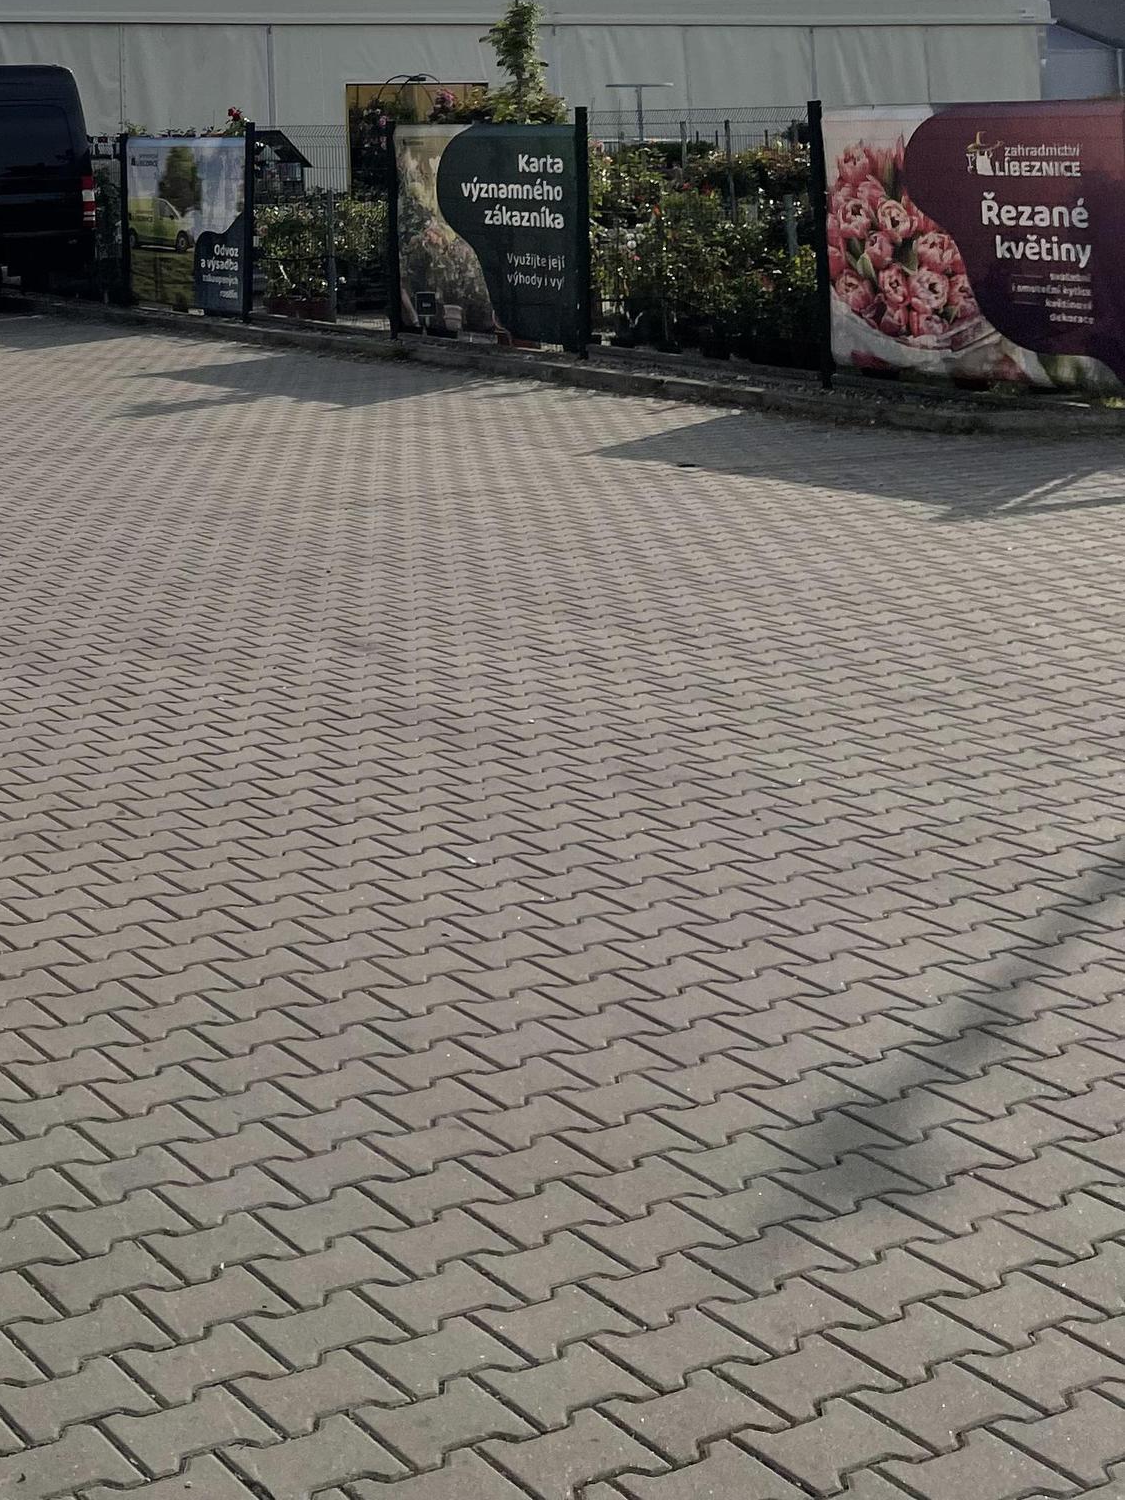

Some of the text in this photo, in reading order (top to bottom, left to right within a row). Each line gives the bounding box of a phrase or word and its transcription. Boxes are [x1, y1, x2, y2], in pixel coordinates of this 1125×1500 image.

[518, 154, 564, 174] Karta
[461, 176, 564, 203] významného
[484, 204, 565, 230] zákazníka
[981, 191, 1089, 228] Řezané
[213, 244, 239, 257] Odvoz
[995, 234, 1092, 269] květiny
[200, 256, 239, 271] a výsadba
[506, 252, 566, 272] Využijte její
[506, 270, 543, 289] výhody
